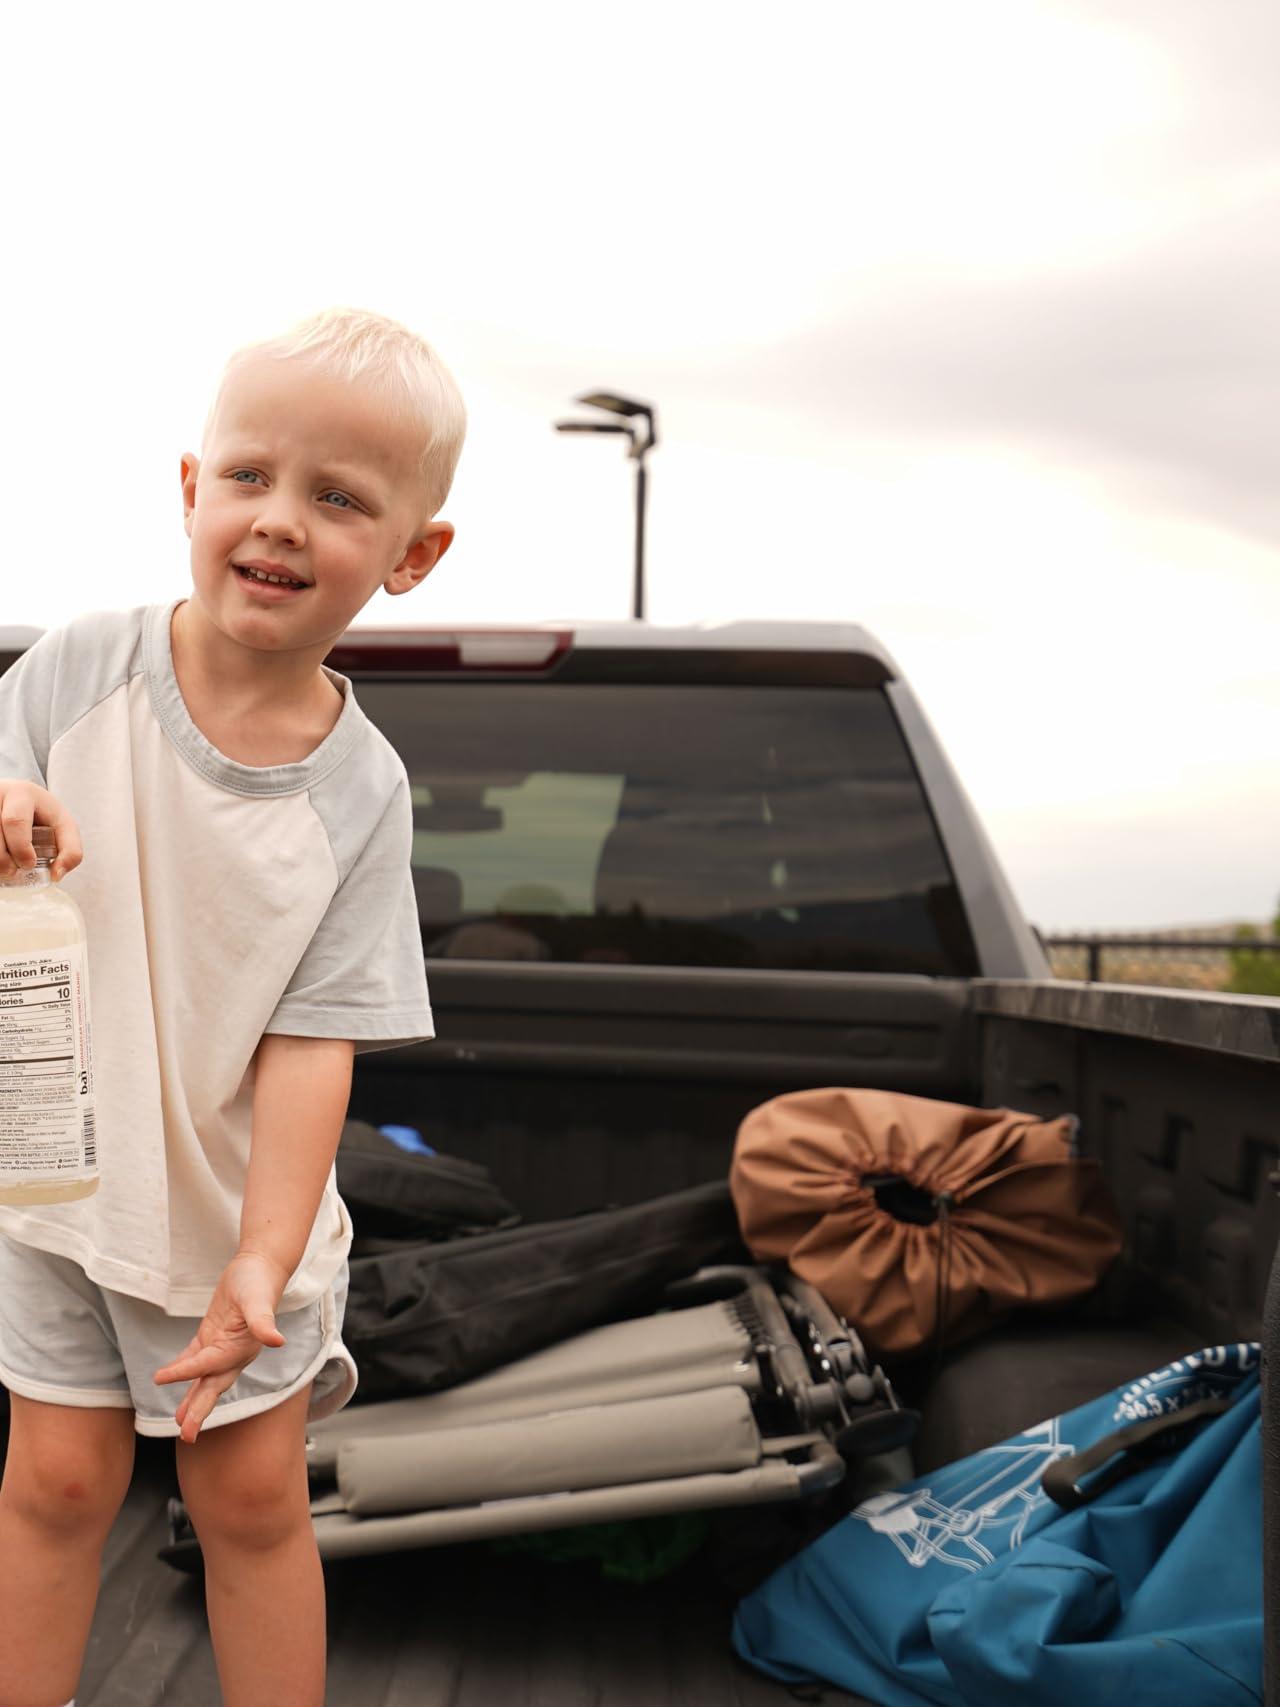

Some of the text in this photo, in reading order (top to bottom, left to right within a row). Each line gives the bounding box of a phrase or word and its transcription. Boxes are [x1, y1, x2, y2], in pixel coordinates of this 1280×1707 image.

[40, 963, 70, 975] Facts
[57, 987, 70, 999] 10
[79, 1070, 88, 1095] bai
